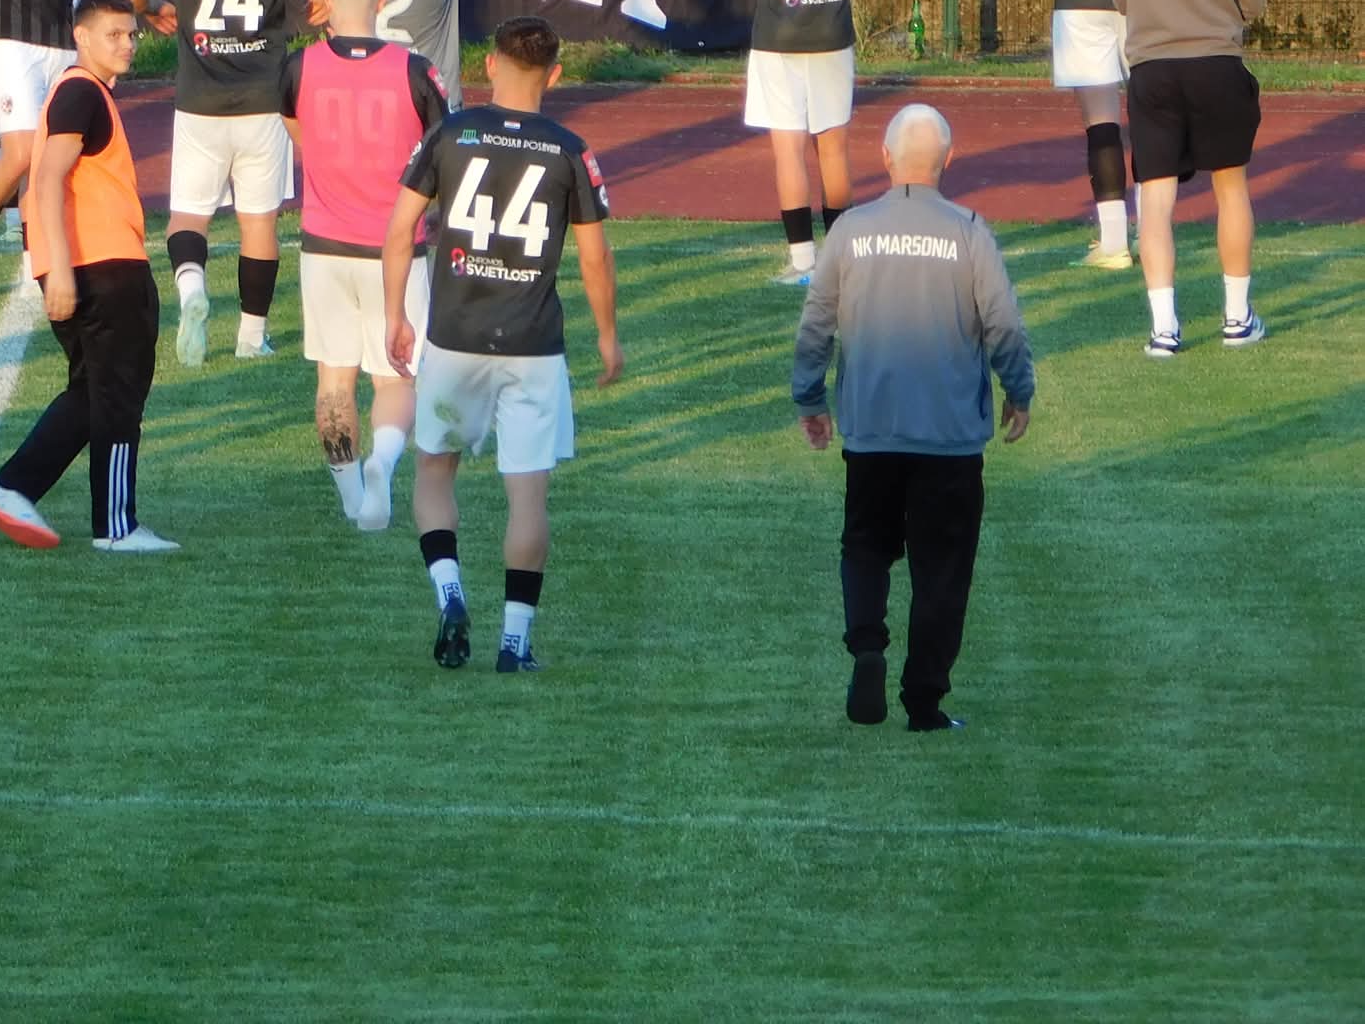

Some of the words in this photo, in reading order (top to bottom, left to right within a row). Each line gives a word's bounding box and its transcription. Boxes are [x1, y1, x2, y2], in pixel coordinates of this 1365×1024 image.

[210, 40, 267, 55] SVJETLOST
[448, 156, 550, 257] 44
[852, 235, 873, 258] NK
[876, 233, 959, 261] MARSONIA
[466, 255, 504, 267] CHROMOS
[466, 263, 540, 283] SVJETLOST
